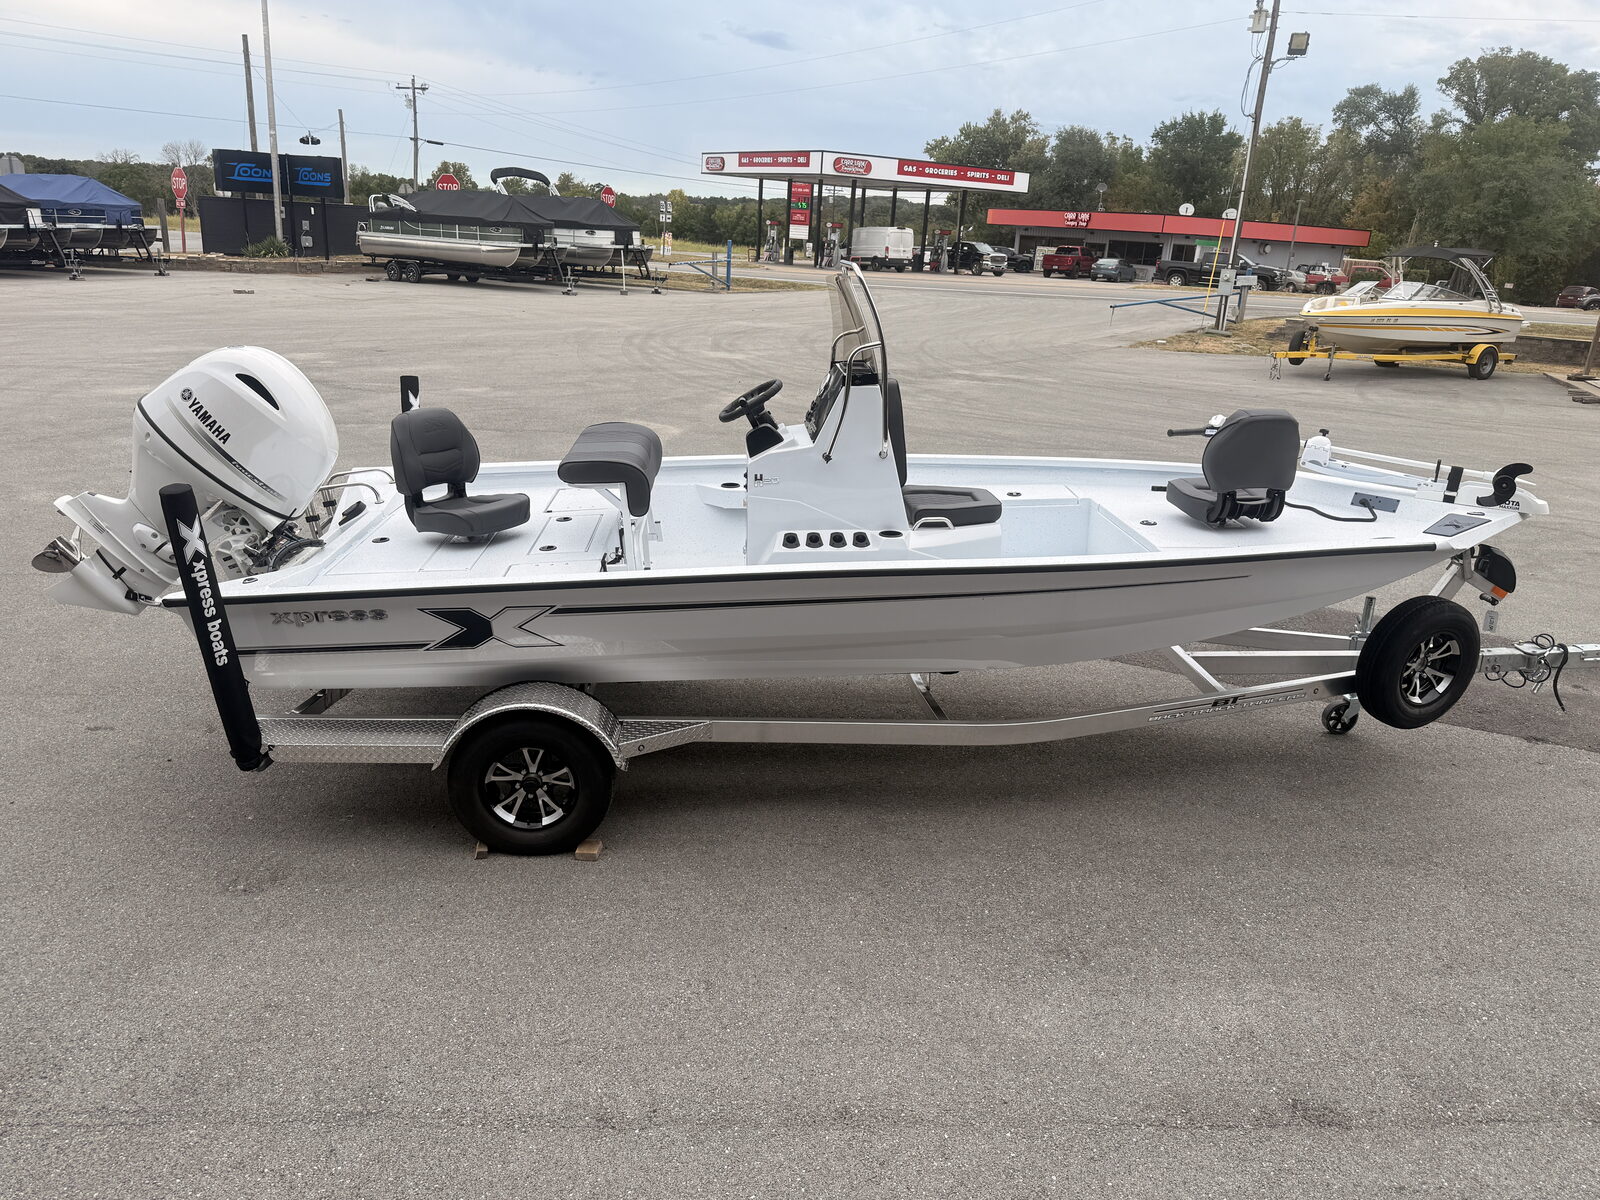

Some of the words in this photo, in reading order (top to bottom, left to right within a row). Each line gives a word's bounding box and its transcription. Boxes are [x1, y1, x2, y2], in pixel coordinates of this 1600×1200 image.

[224, 162, 273, 182] TOON
[293, 167, 332, 186] TOONS
[903, 165, 917, 173] GAS
[925, 167, 958, 176] GROCERIES
[967, 171, 990, 179] SPIRITS
[172, 177, 186, 189] STOP
[602, 194, 615, 204] STOP
[188, 397, 231, 445] YAMAHA
[191, 559, 217, 618] xpress
[207, 618, 229, 667] boats
[270, 608, 389, 628] xpress
